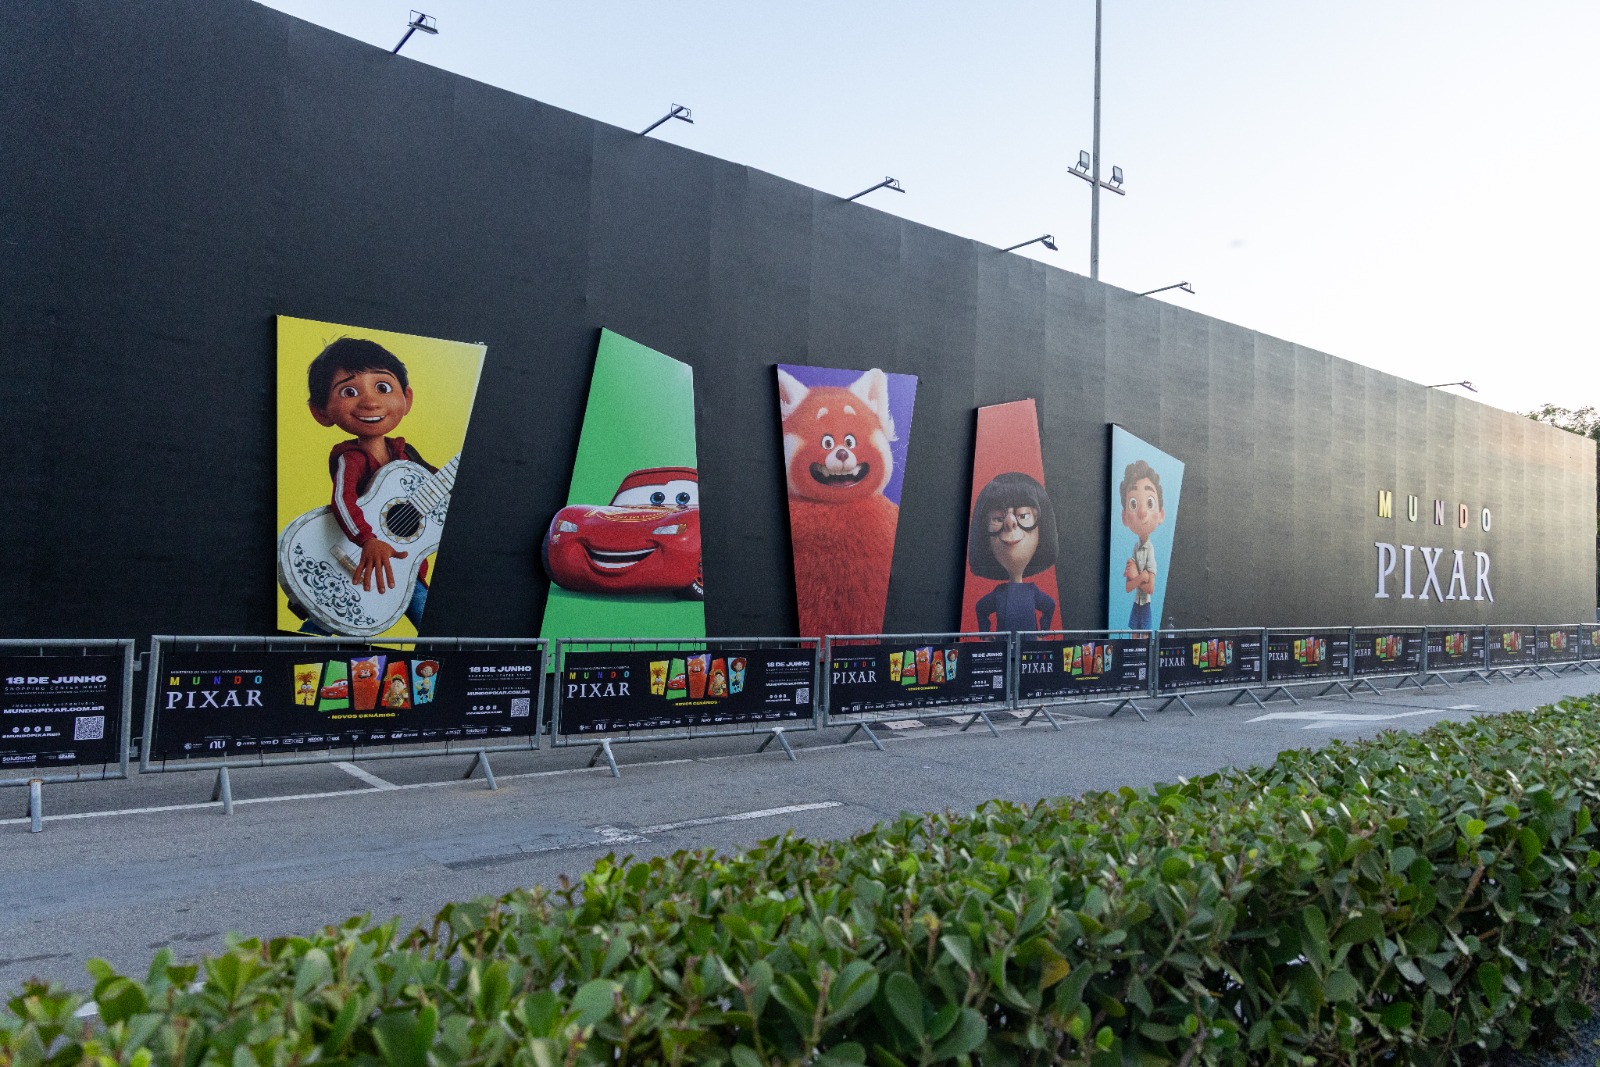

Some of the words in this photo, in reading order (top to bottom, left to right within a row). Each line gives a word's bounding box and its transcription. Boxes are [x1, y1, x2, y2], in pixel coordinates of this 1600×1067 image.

[1378, 490, 1491, 532] MUNDO
[1374, 541, 1494, 602] PIXAR
[1160, 657, 1186, 668] PIXAR
[1268, 652, 1289, 661] PIXAR
[1021, 662, 1053, 674] PIXAR
[27, 676, 49, 684] DE
[52, 675, 107, 684] JUNHO
[170, 675, 262, 685] MUNDO
[569, 671, 629, 679] MUNDO
[832, 670, 877, 684] PIXAR
[567, 682, 630, 698] PIXAR
[165, 689, 263, 709] PIXAR
